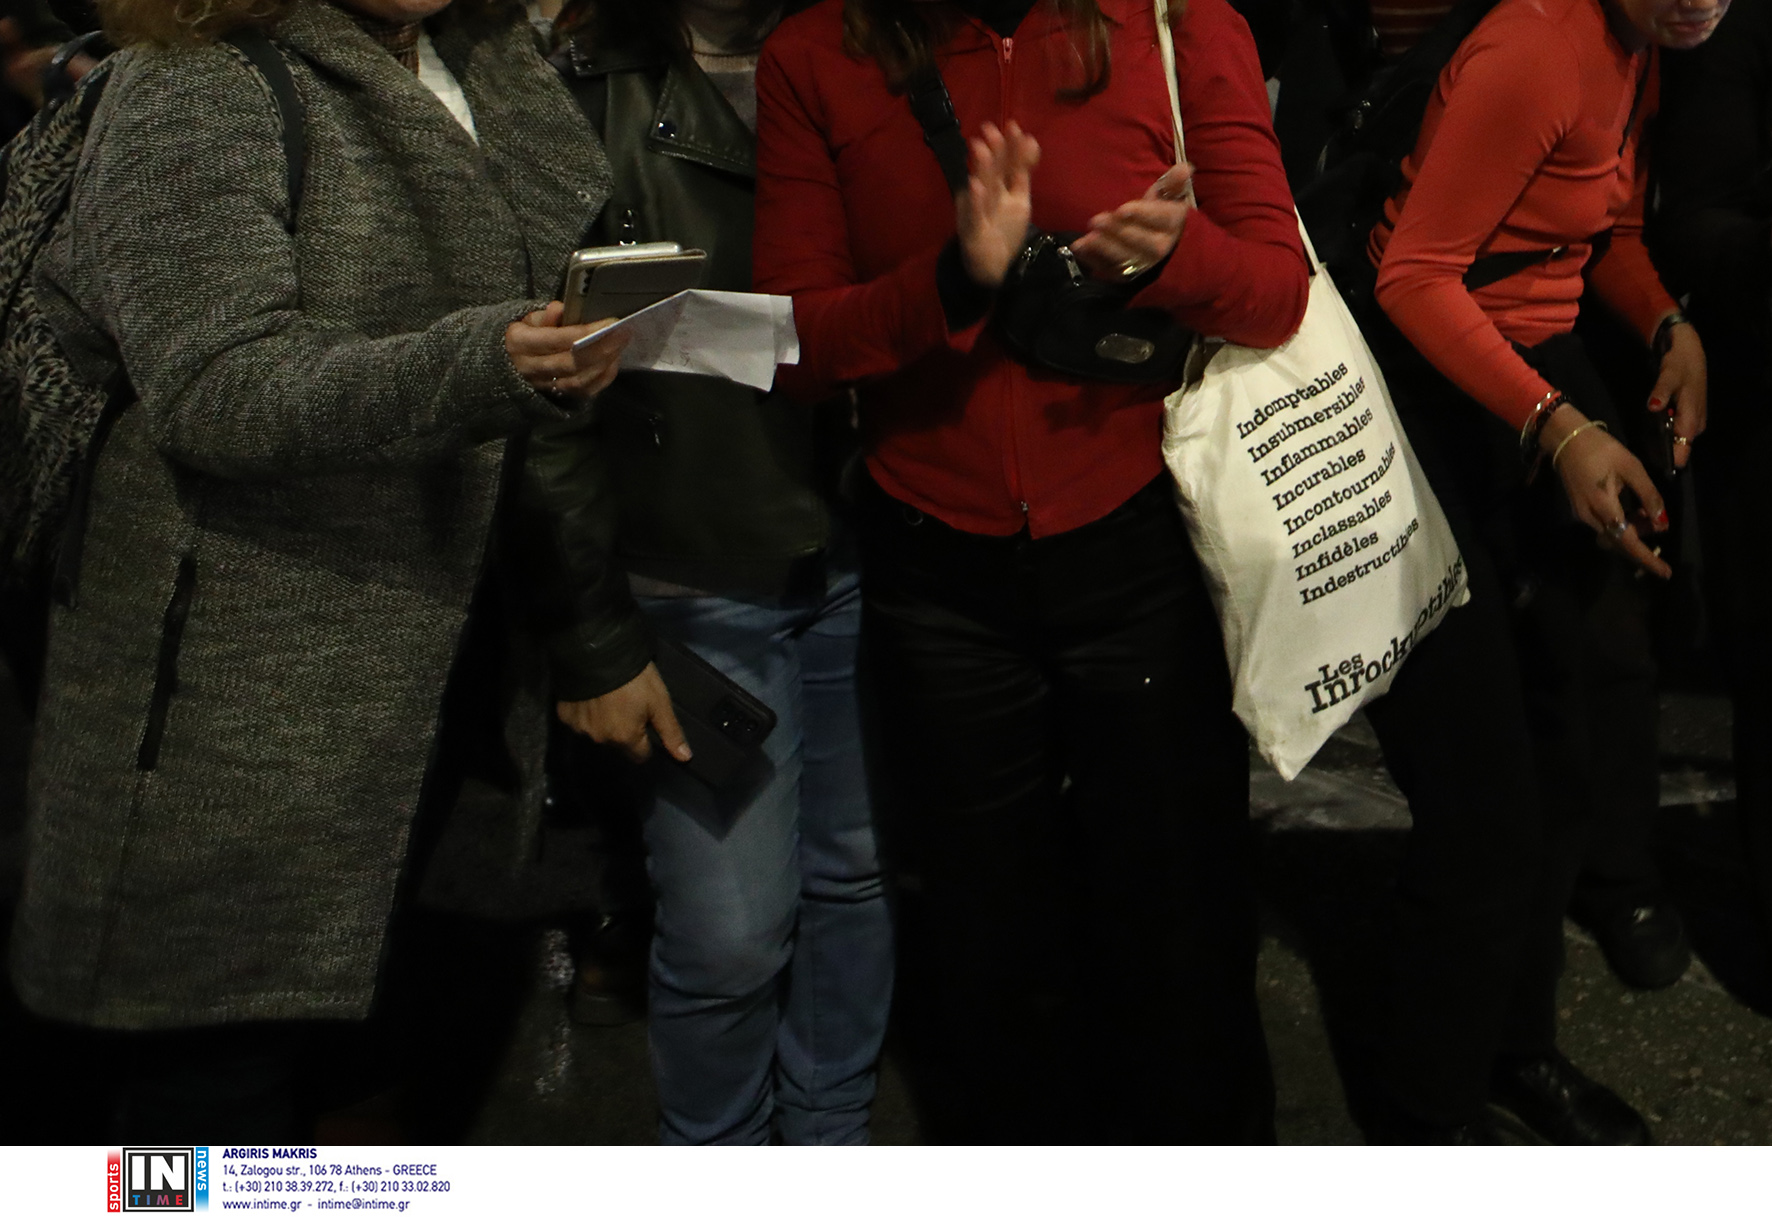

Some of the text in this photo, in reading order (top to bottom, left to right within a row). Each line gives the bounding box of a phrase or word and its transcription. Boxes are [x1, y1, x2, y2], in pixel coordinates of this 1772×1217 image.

[1236, 361, 1349, 440] Indomptables
[1247, 376, 1366, 464] Insubmersibles
[1260, 407, 1374, 487] Inflammables
[1272, 448, 1367, 512] Incurables
[1283, 441, 1396, 536] Incontournables
[1291, 489, 1393, 560] Inclassables
[1294, 530, 1380, 582] Infidèles
[1299, 517, 1420, 606] Indestructibes
[1318, 653, 1364, 685] Les
